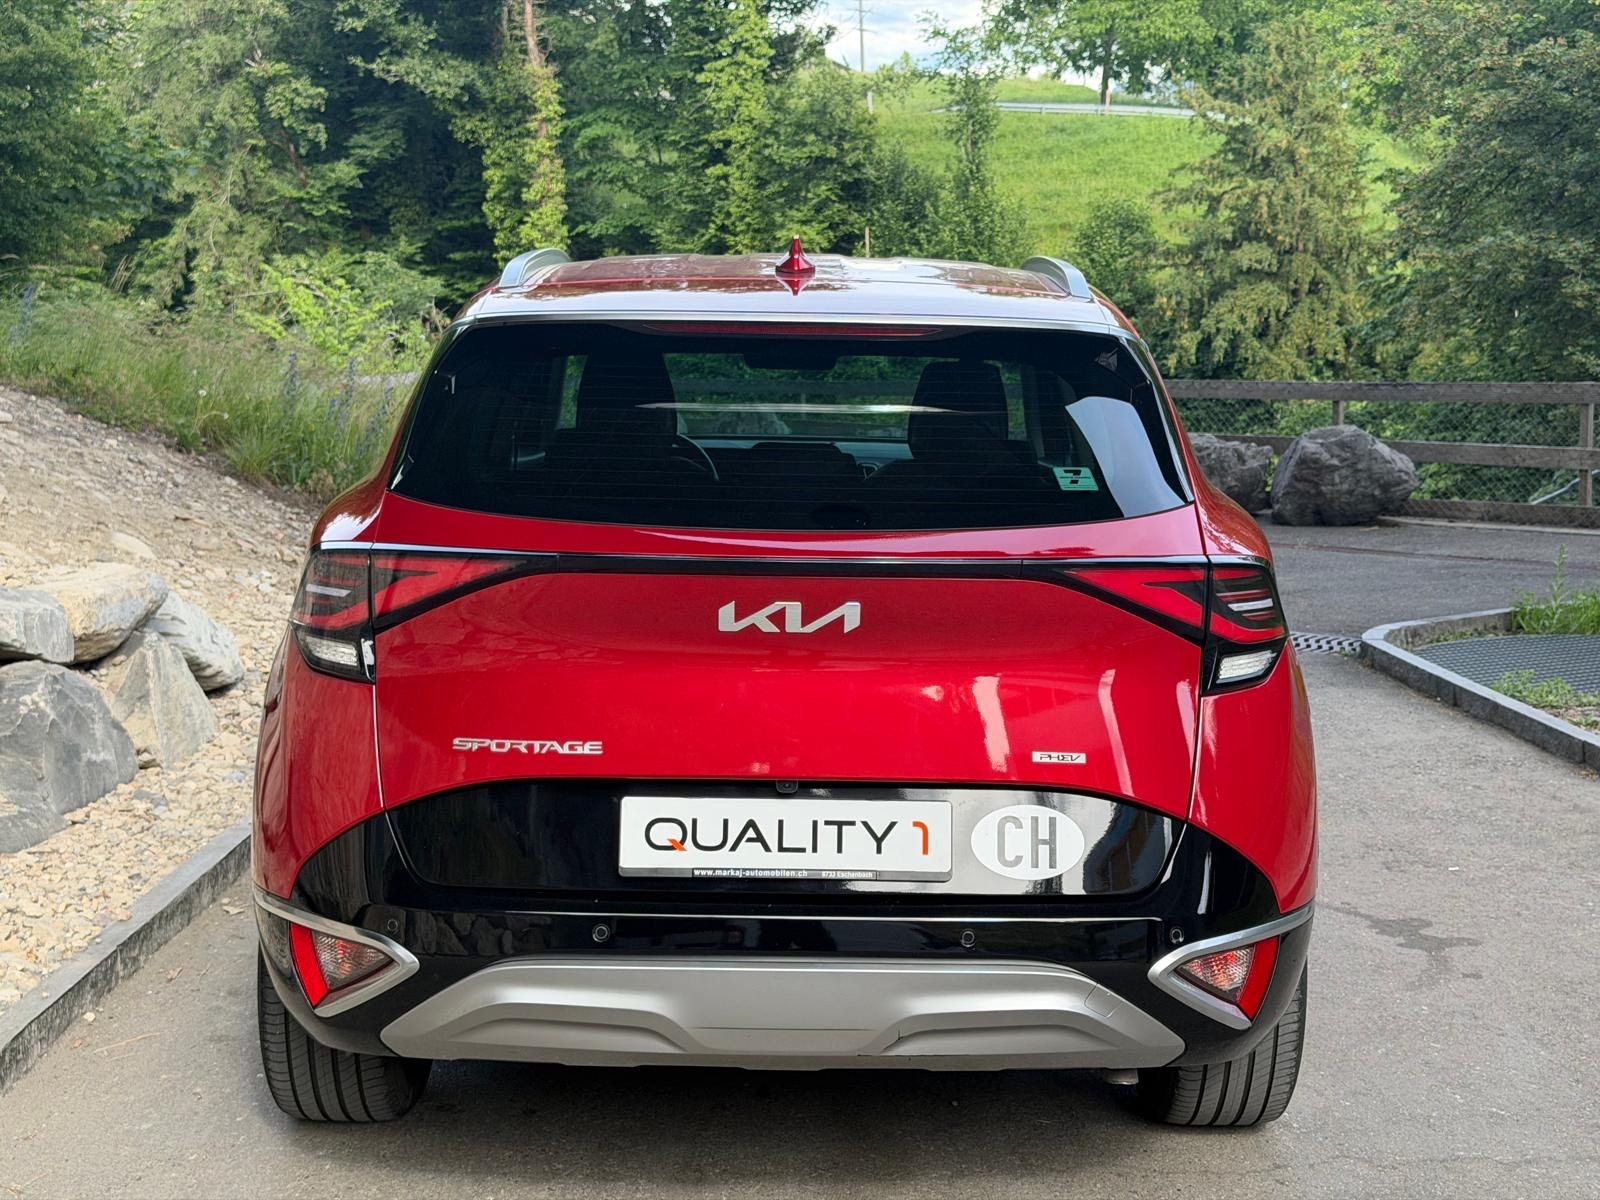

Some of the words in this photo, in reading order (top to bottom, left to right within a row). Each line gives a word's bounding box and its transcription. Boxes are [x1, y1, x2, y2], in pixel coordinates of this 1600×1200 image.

[718, 601, 861, 634] KIA
[452, 737, 604, 756] SPORTAGE
[1039, 753, 1081, 762] PHEV
[644, 817, 898, 855] QUALITY
[912, 820, 929, 856] 1
[996, 815, 1057, 869] CH
